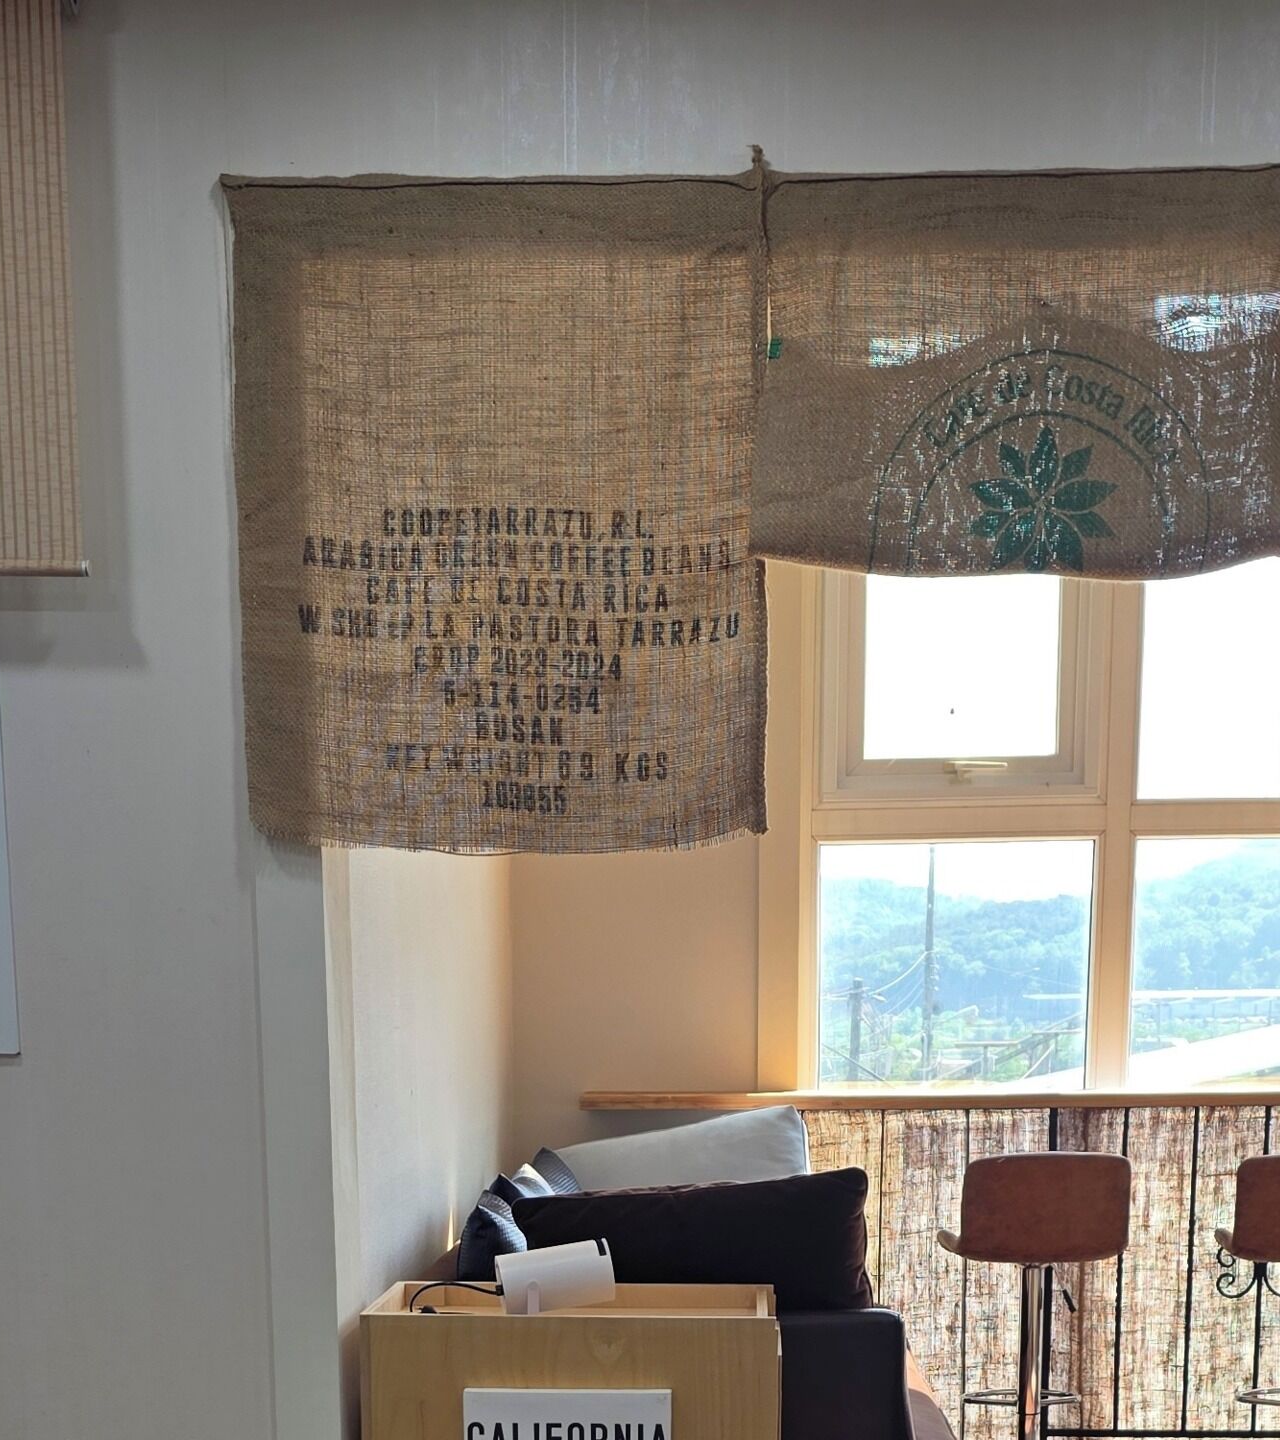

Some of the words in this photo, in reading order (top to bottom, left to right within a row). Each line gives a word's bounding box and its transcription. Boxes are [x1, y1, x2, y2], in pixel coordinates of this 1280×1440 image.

[1042, 364, 1124, 420] Costa
[303, 535, 423, 571] ARABICA
[435, 538, 517, 569] GREEN
[534, 542, 631, 577] COFFEE
[642, 539, 731, 577] BEANS
[367, 575, 438, 604] CAFE
[497, 576, 586, 611] COSTA
[603, 582, 669, 613] RICA
[426, 609, 455, 639] LA
[472, 613, 599, 647] PASTORA
[616, 612, 741, 648] TARRAZU
[491, 646, 621, 681] 2023-2024
[475, 713, 563, 746] BUSAN
[558, 751, 594, 781] 69
[615, 752, 669, 783] KGS
